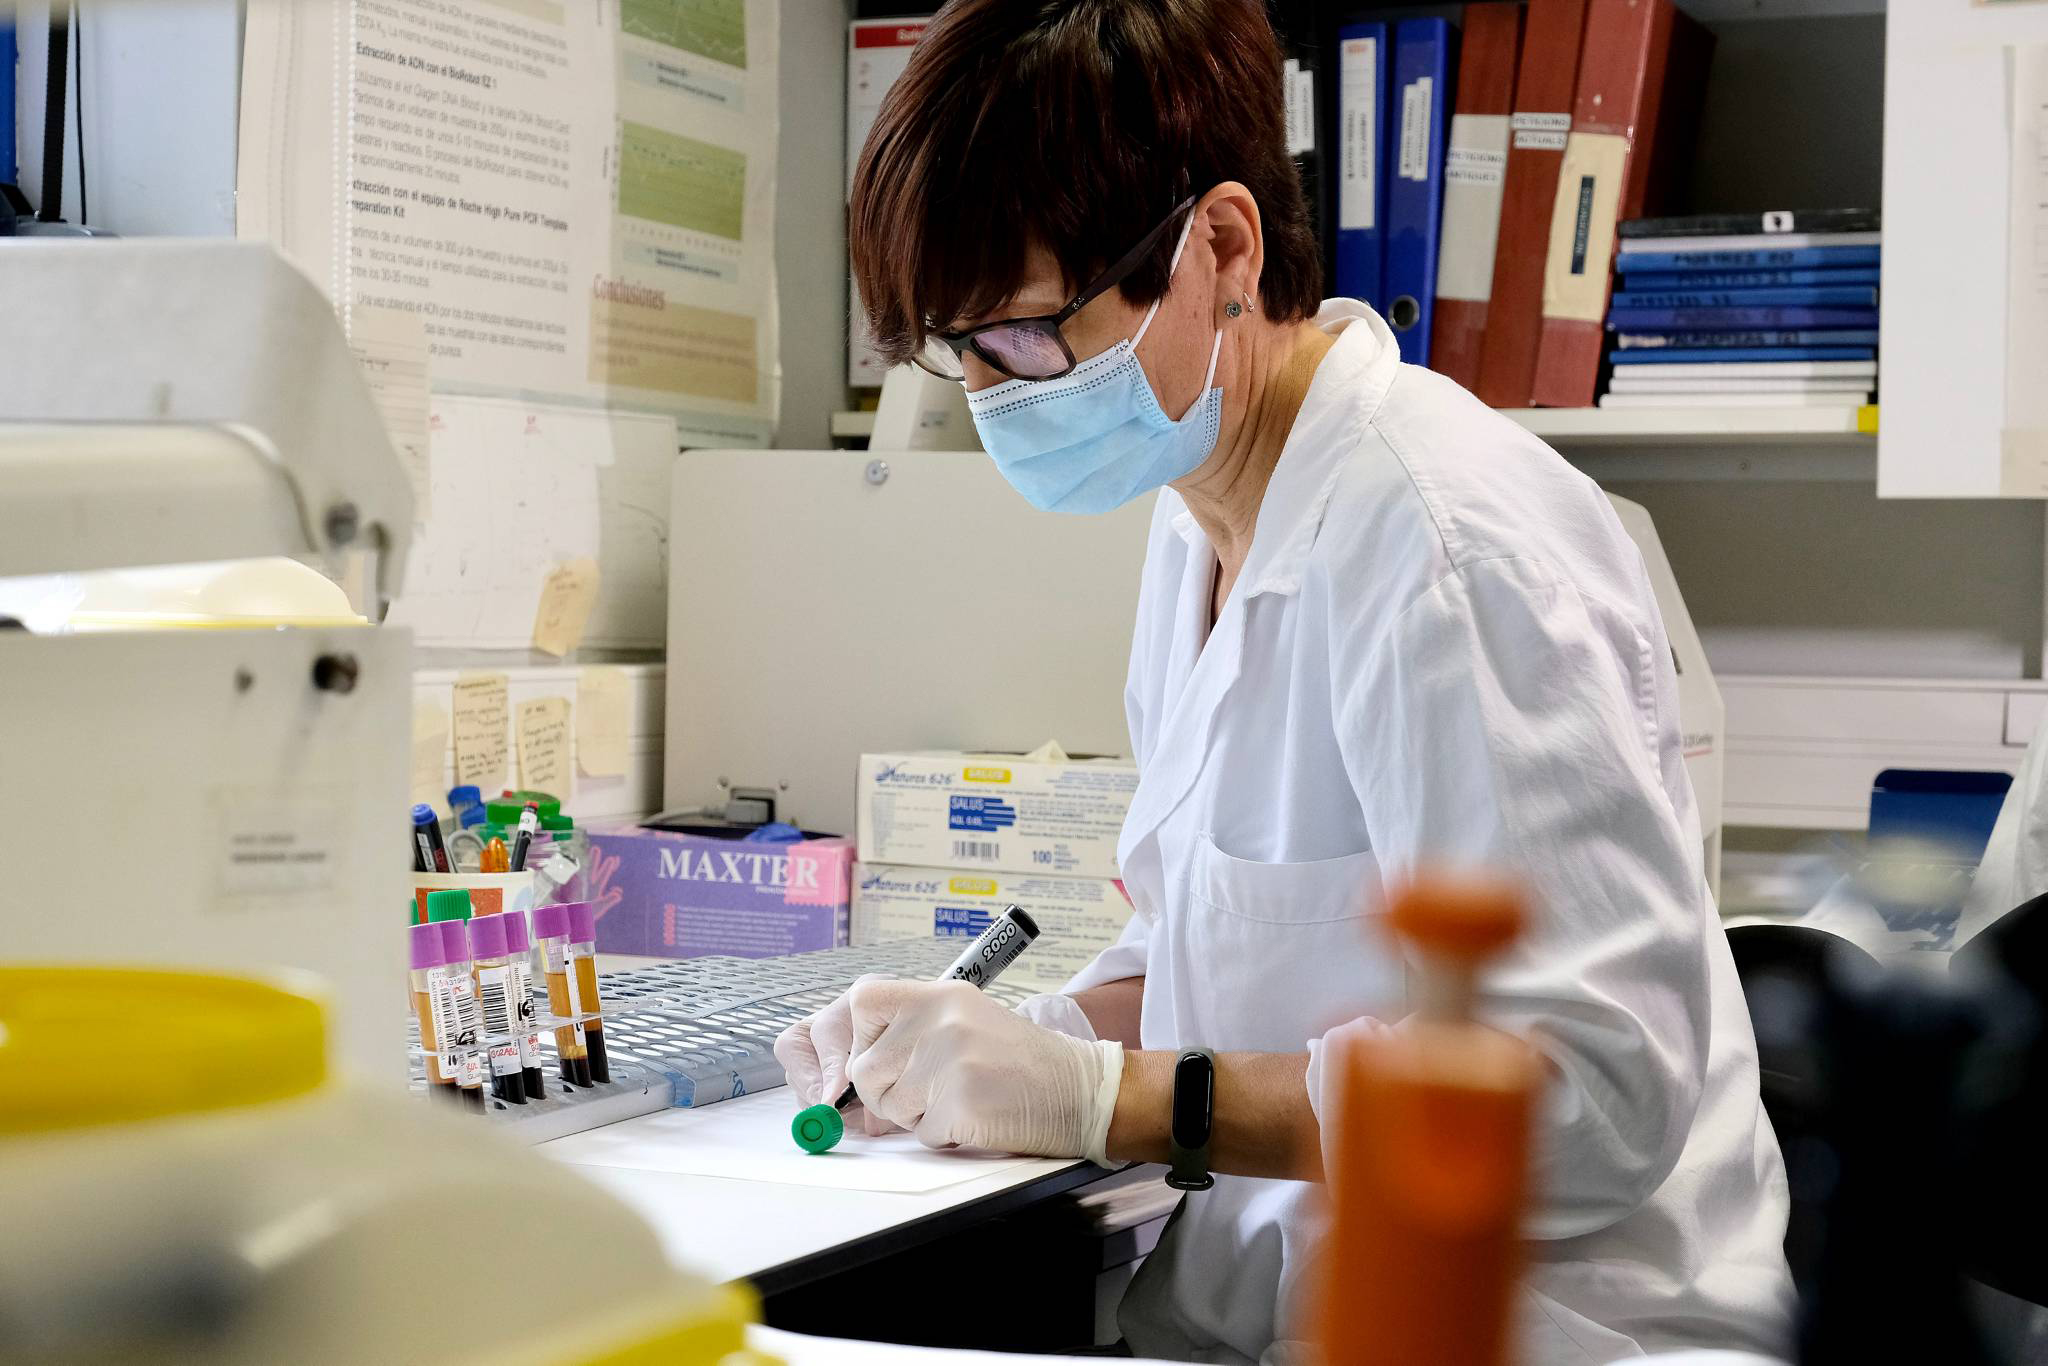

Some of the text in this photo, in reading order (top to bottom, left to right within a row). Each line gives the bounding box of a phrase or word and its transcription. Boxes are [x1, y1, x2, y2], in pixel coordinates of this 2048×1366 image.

[593, 274, 666, 310] Conclusiones
[951, 797, 985, 811] SALUS
[657, 847, 819, 888] MAXTER
[1032, 850, 1052, 864] 100
[936, 909, 969, 923] SALUS
[982, 922, 1017, 963] 2000
